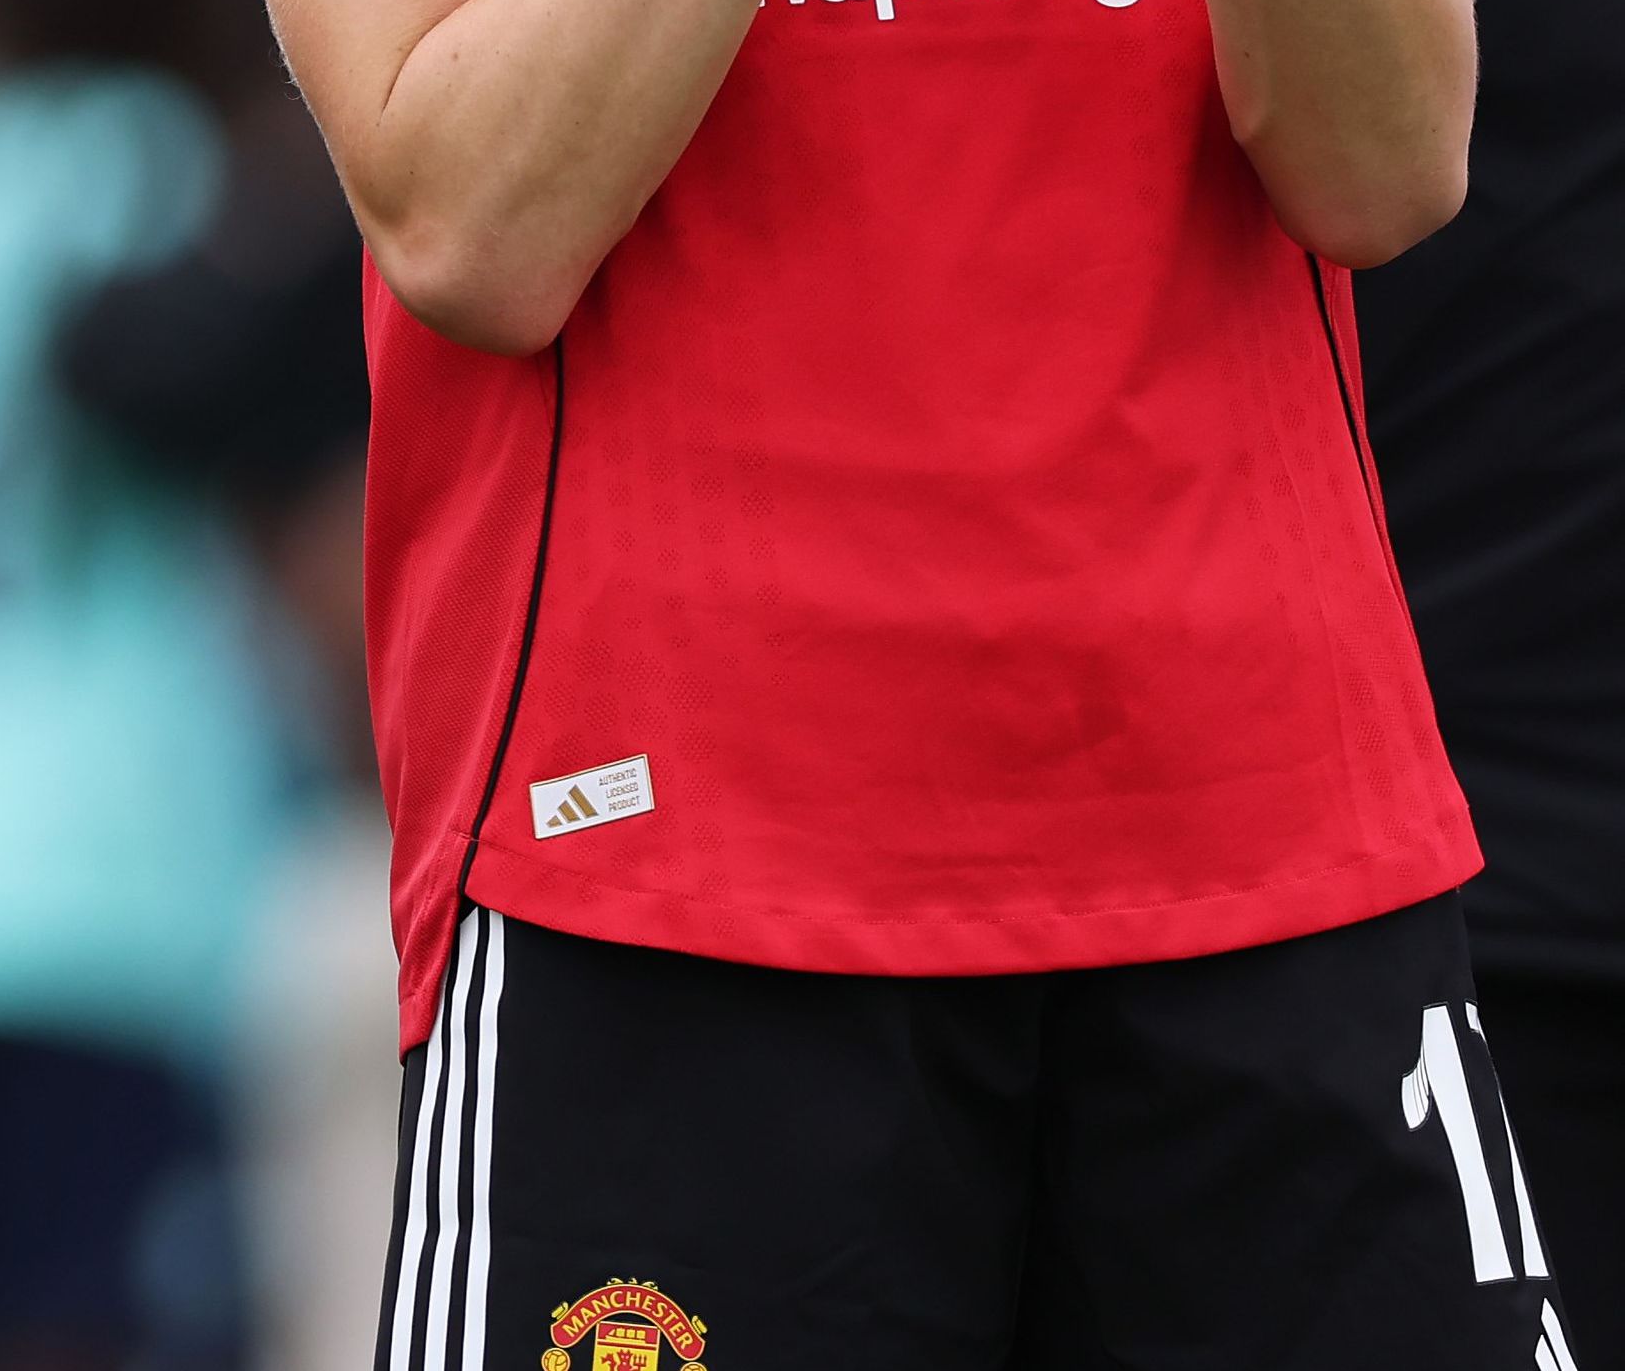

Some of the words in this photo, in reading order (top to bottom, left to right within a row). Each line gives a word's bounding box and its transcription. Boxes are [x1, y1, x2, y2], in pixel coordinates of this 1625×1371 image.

[599, 768, 637, 786] AUTHENTIC
[606, 782, 639, 799] LICENSED
[609, 796, 640, 812] PRODUCT
[562, 1290, 693, 1351] MANCHESTER
